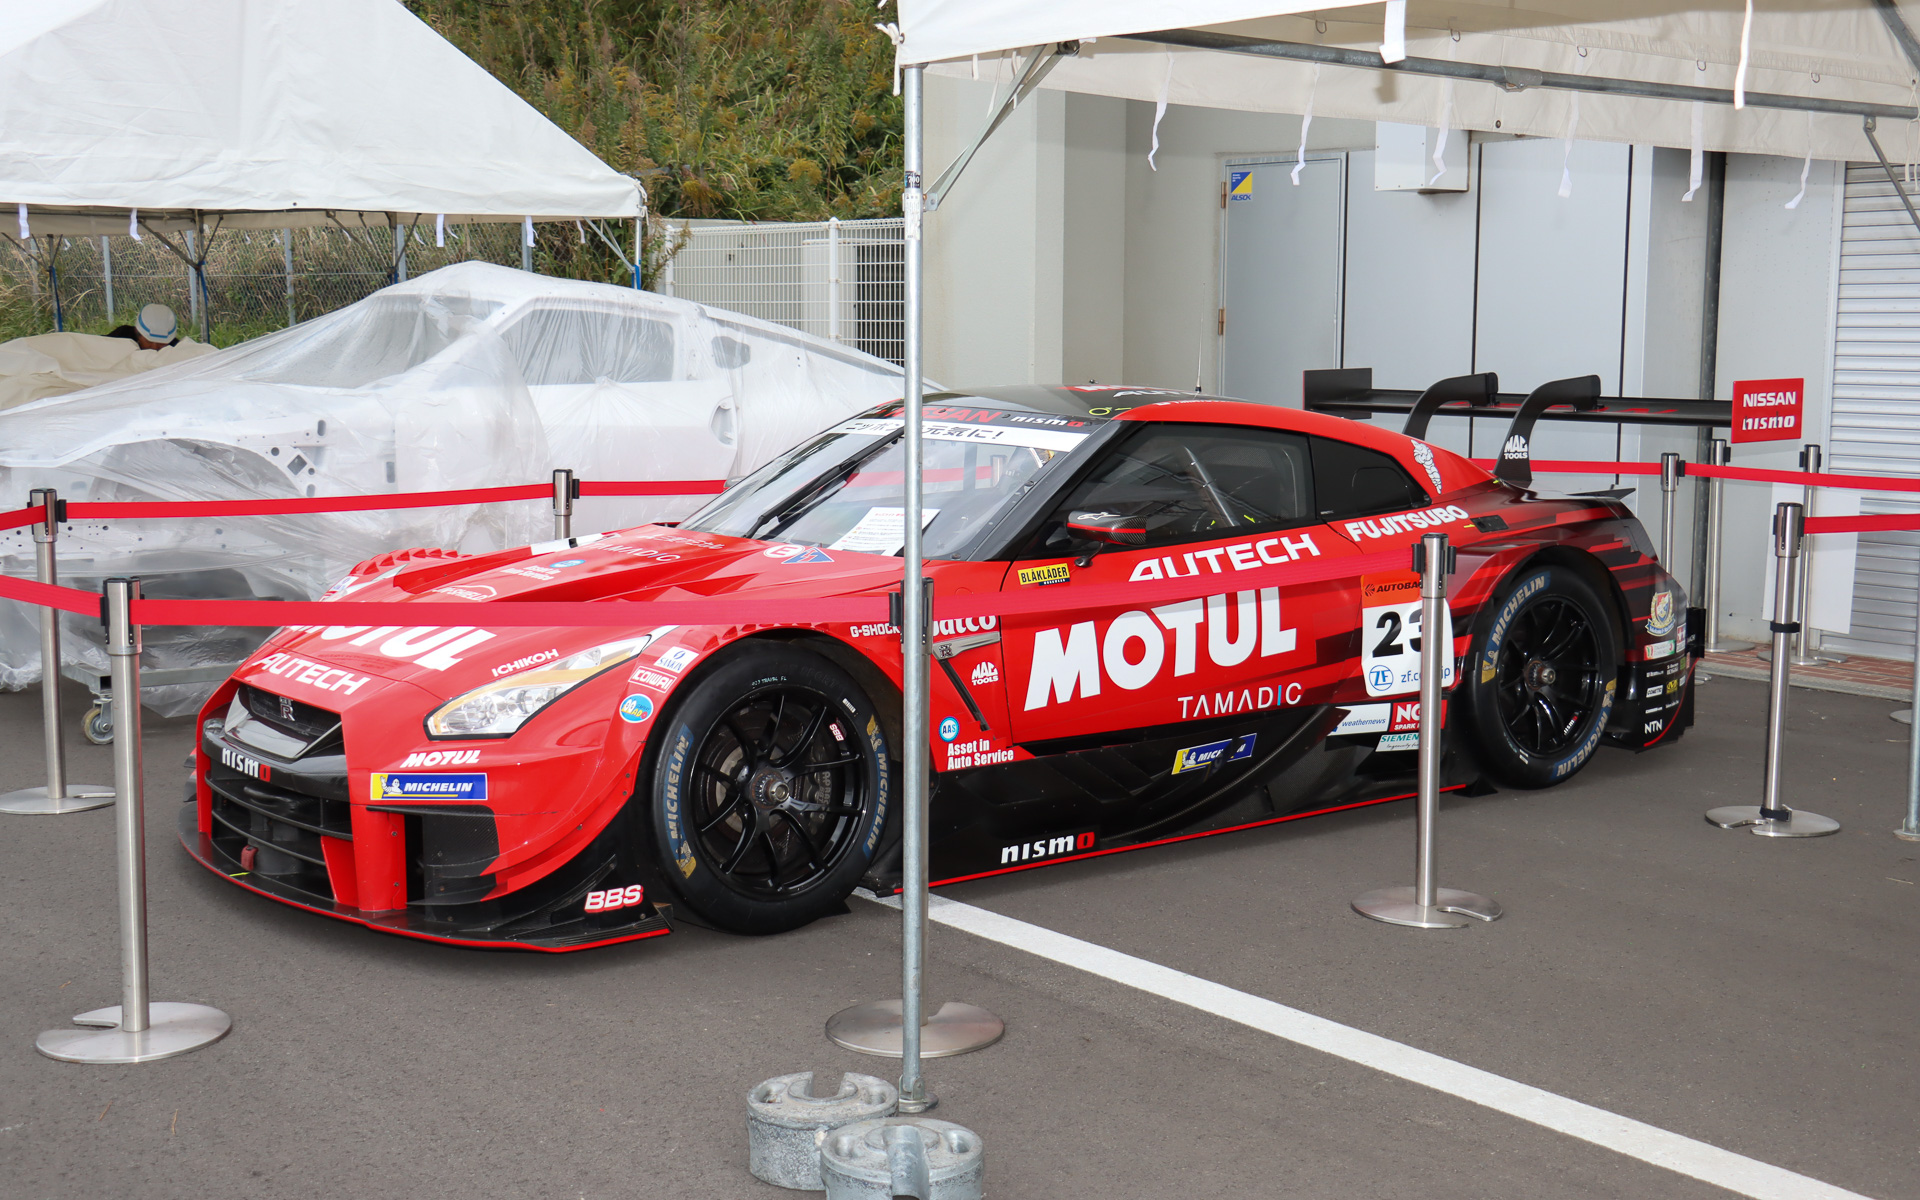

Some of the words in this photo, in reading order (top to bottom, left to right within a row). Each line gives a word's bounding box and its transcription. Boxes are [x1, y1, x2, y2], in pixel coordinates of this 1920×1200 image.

[1743, 391, 1796, 407] NISSAN
[1011, 416, 1084, 427] nismo
[1742, 415, 1795, 430] nismo
[846, 422, 1004, 440] ニッポン元気に!
[1504, 435, 1528, 452] MAC
[1504, 452, 1528, 460] TOOLS
[1344, 504, 1469, 542] FUJITSUBO
[1129, 533, 1321, 582] AUTECH
[1021, 566, 1068, 583] BLÅKLÄDER
[1377, 581, 1422, 592] AUTOBA
[1491, 575, 1545, 646] MICHELIN
[1024, 586, 1297, 711] MOTUL
[491, 649, 559, 677] ICHIKOH
[971, 661, 998, 679] MAC
[251, 652, 371, 696] AUTECH
[971, 675, 999, 686] TOOLS
[1371, 670, 1392, 687] ZF
[1177, 682, 1302, 719] TAMADIC
[1396, 703, 1421, 722] NG
[942, 724, 956, 734] AAS
[1342, 718, 1386, 727] weathernews
[1394, 723, 1416, 731] SPARK
[1644, 719, 1662, 735] NTN
[829, 723, 844, 741] BBS
[1381, 734, 1421, 743] SIEMEN
[947, 743, 977, 756] Asset
[979, 738, 990, 752] in
[1557, 711, 1608, 777] MICHELIN
[222, 748, 271, 782] nismo
[400, 750, 481, 768] MOTUL
[947, 756, 972, 770] Auto
[974, 749, 1014, 766] Service
[404, 782, 473, 793] MICHELIN
[667, 735, 689, 839] MICHELIN
[867, 753, 888, 851] MICHELIN
[1000, 832, 1095, 864] nismo
[584, 884, 643, 913] BBS
